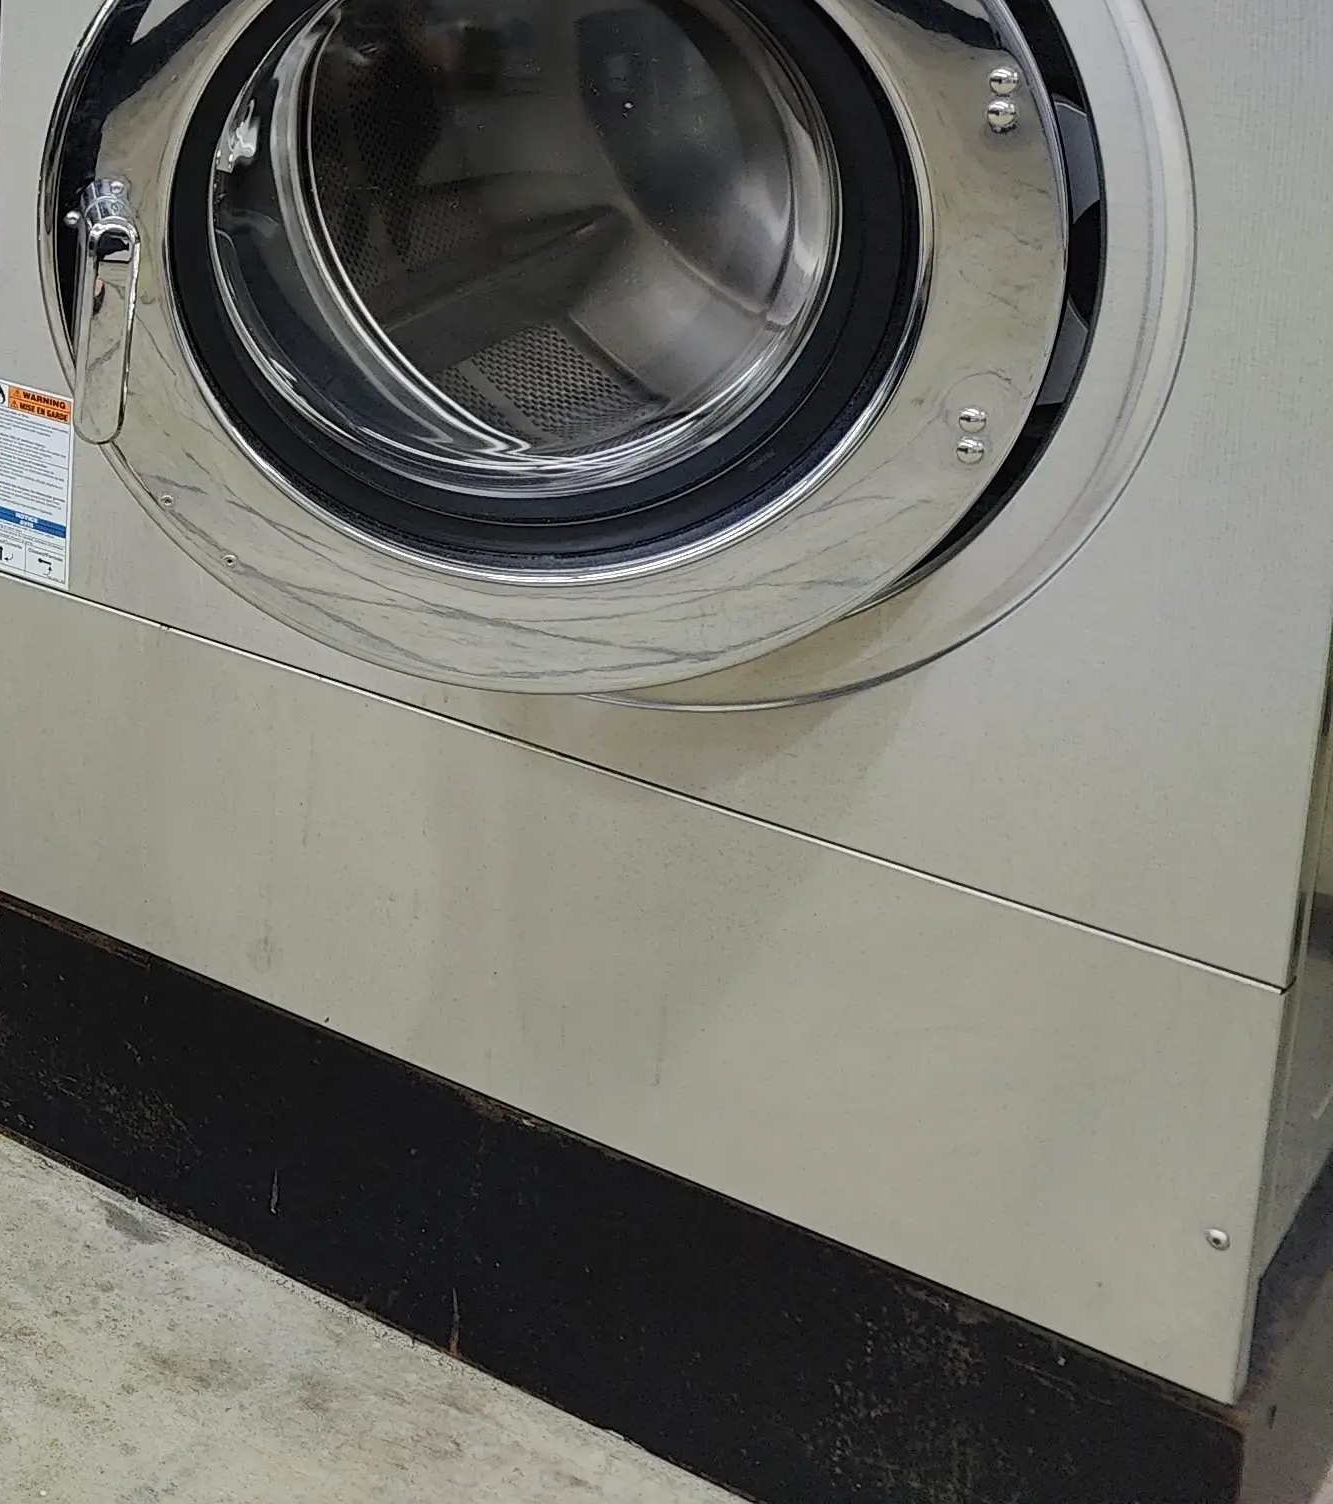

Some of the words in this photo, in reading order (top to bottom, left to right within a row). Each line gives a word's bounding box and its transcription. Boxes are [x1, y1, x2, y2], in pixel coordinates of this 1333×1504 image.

[22, 391, 66, 409] WARNING
[20, 402, 35, 413] MISE
[37, 407, 46, 415] EN
[47, 410, 68, 422] GARDE
